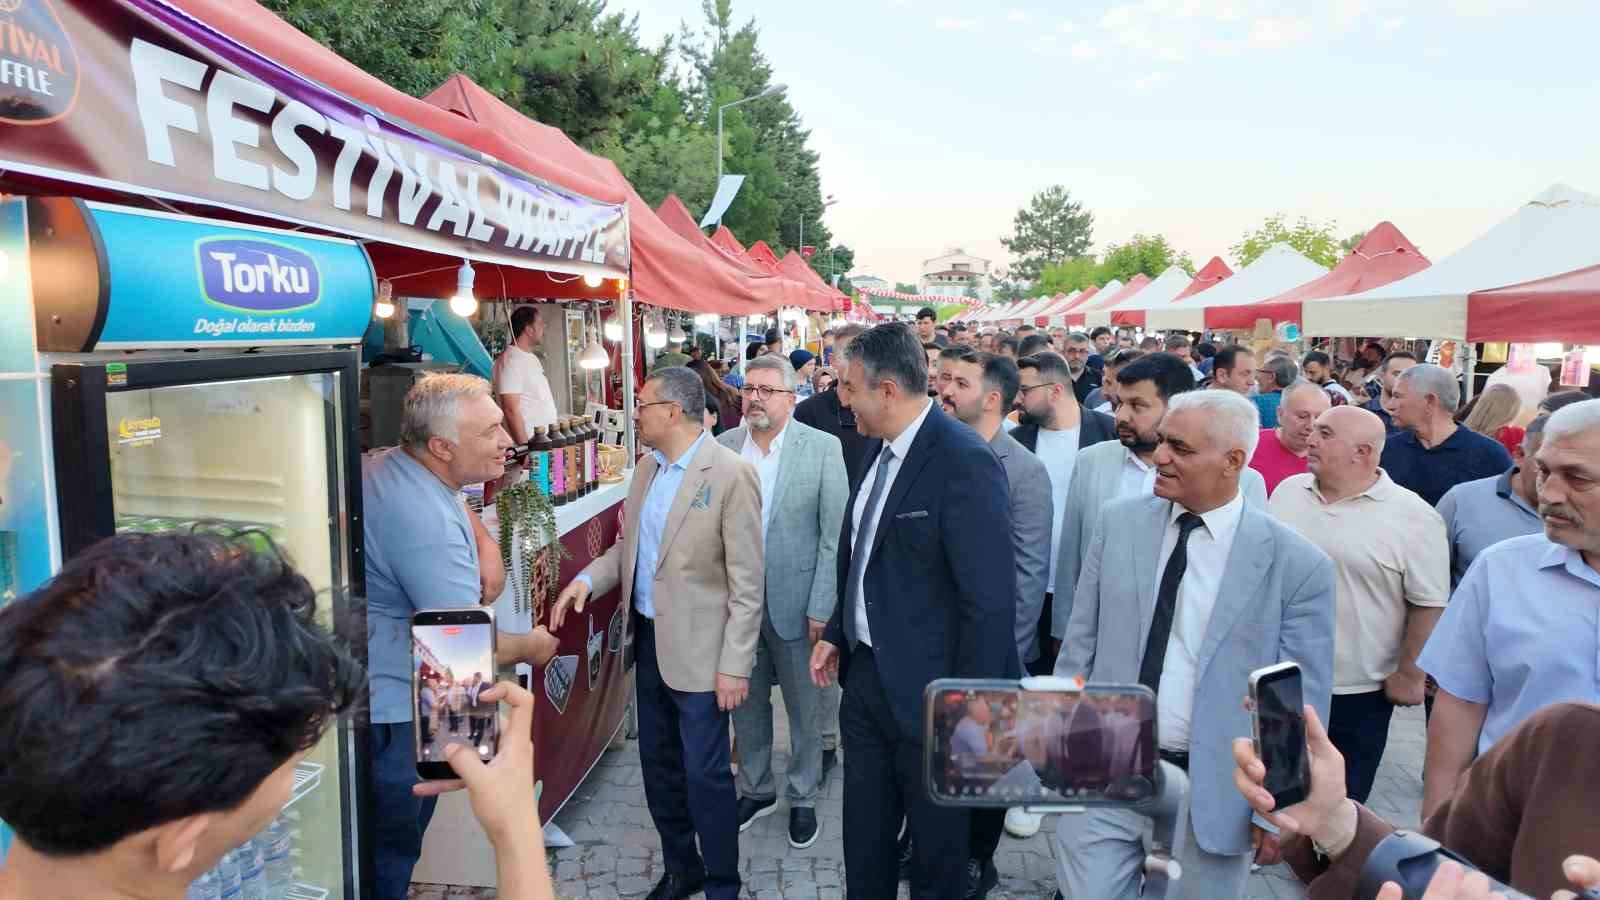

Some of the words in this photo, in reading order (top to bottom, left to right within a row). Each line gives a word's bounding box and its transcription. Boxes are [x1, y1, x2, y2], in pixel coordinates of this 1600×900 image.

[131, 37, 495, 243] FESTİVAL
[209, 251, 310, 294] Torku
[193, 317, 238, 336] Doğal
[237, 315, 277, 333] olarak
[277, 318, 316, 333] bizden
